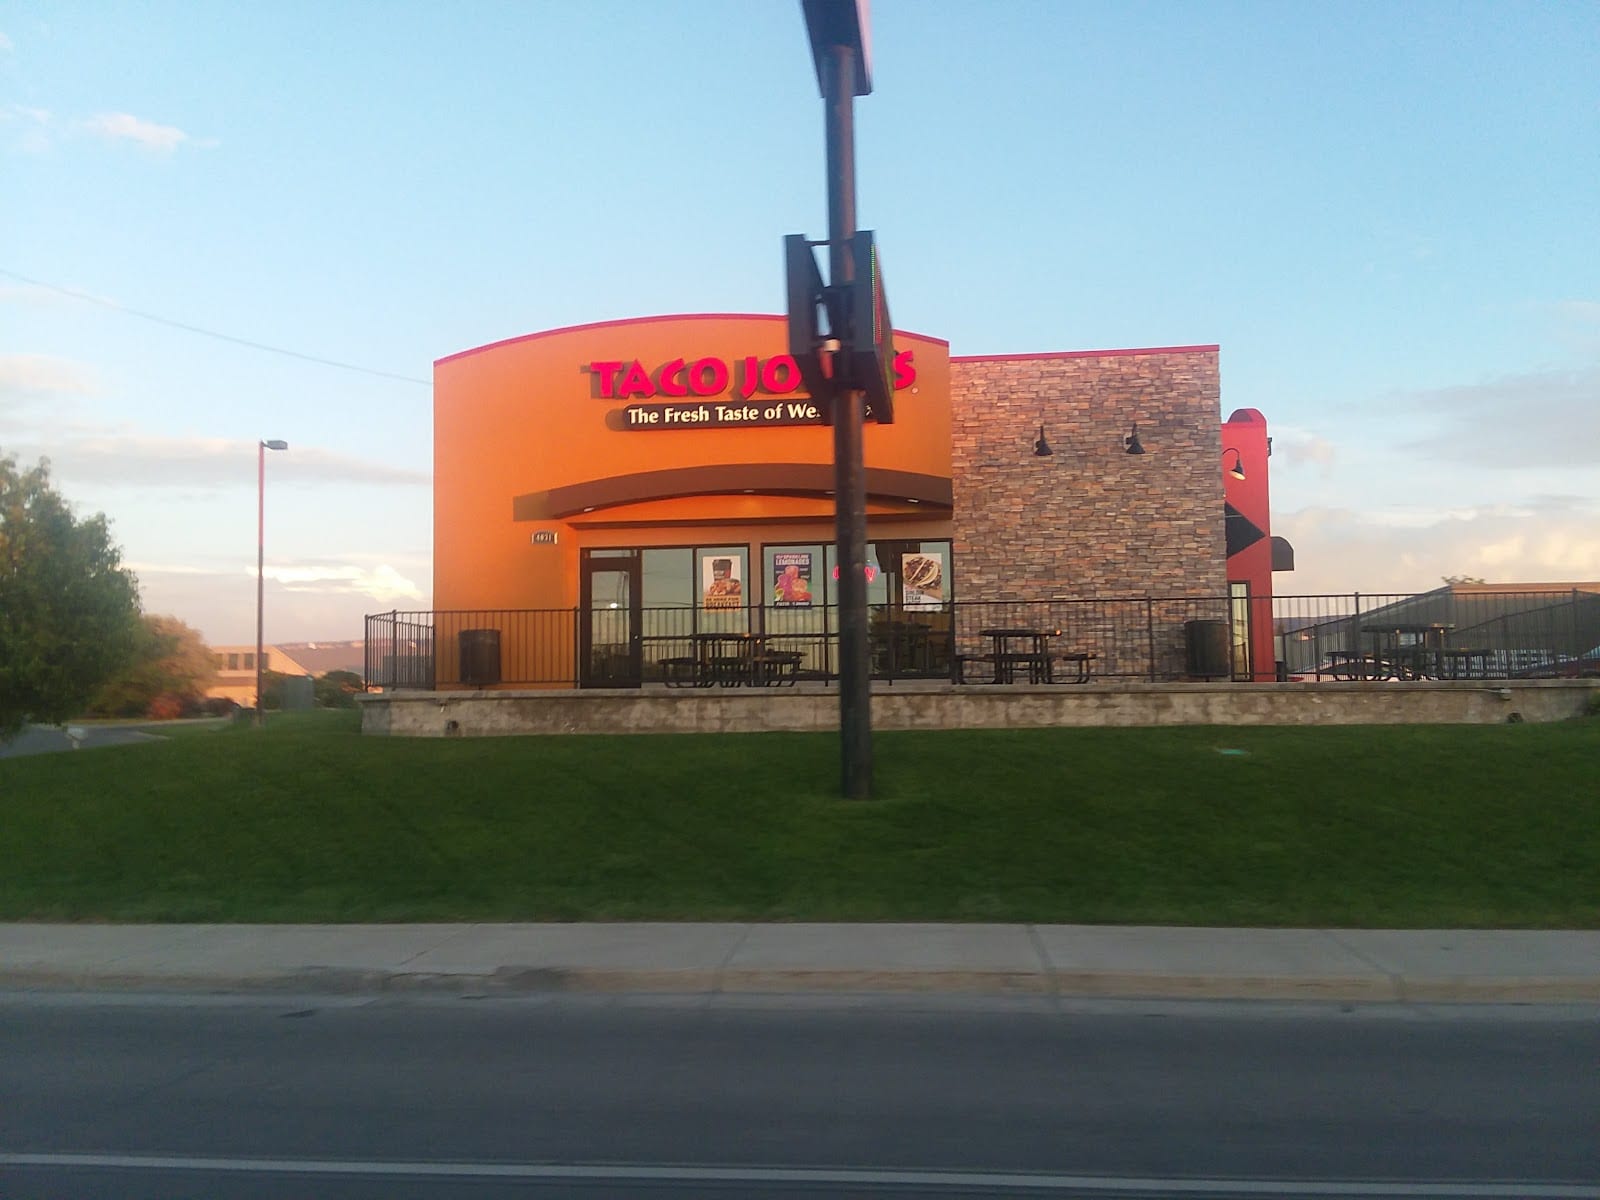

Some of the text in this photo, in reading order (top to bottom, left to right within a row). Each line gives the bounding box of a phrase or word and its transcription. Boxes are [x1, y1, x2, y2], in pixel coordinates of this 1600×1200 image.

[590, 351, 916, 398] TACO JOS
[628, 408, 659, 424] The
[664, 406, 710, 423] Fresh
[715, 405, 759, 421] Taste
[764, 403, 784, 420] of
